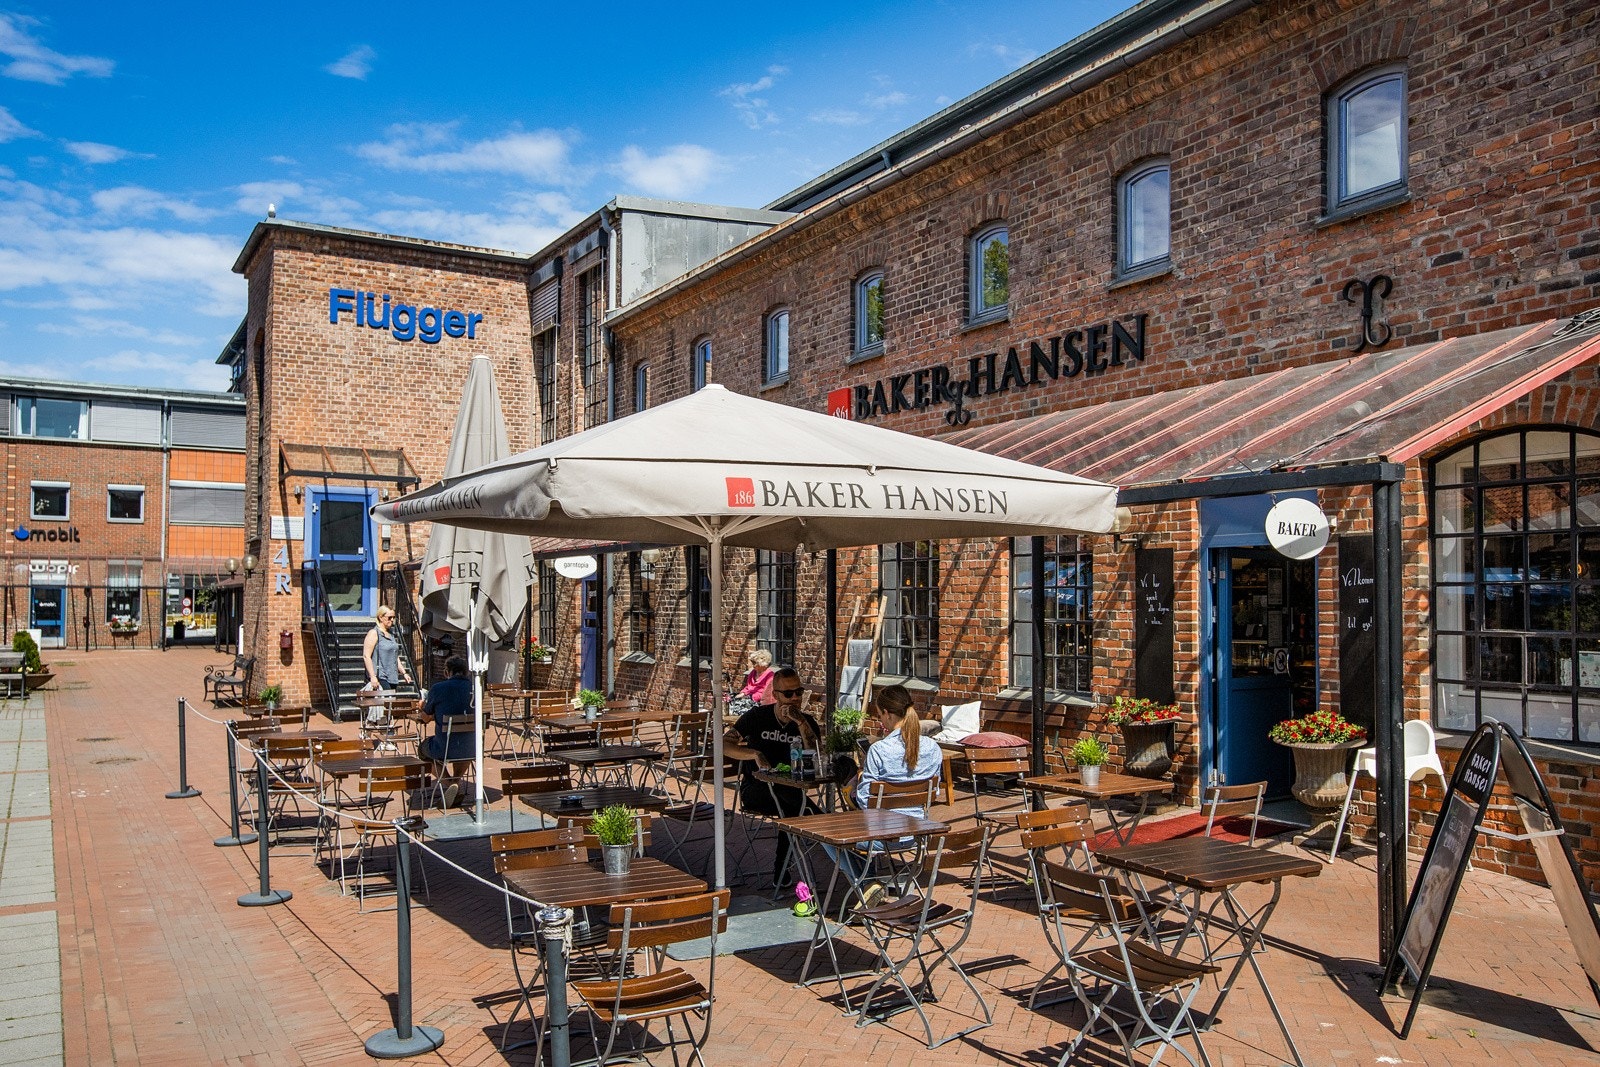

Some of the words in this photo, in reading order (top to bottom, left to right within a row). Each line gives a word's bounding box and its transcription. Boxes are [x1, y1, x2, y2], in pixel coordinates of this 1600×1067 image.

[329, 288, 483, 344] Flügger
[854, 364, 950, 422] BAKER
[967, 313, 1147, 398] HANSEN
[758, 480, 872, 509] BAKER
[882, 484, 1008, 515] HANSEN
[30, 526, 81, 543] mobit
[1277, 521, 1317, 537] BAKER
[273, 544, 290, 569] 4
[451, 561, 481, 579] ER
[274, 572, 292, 596] R
